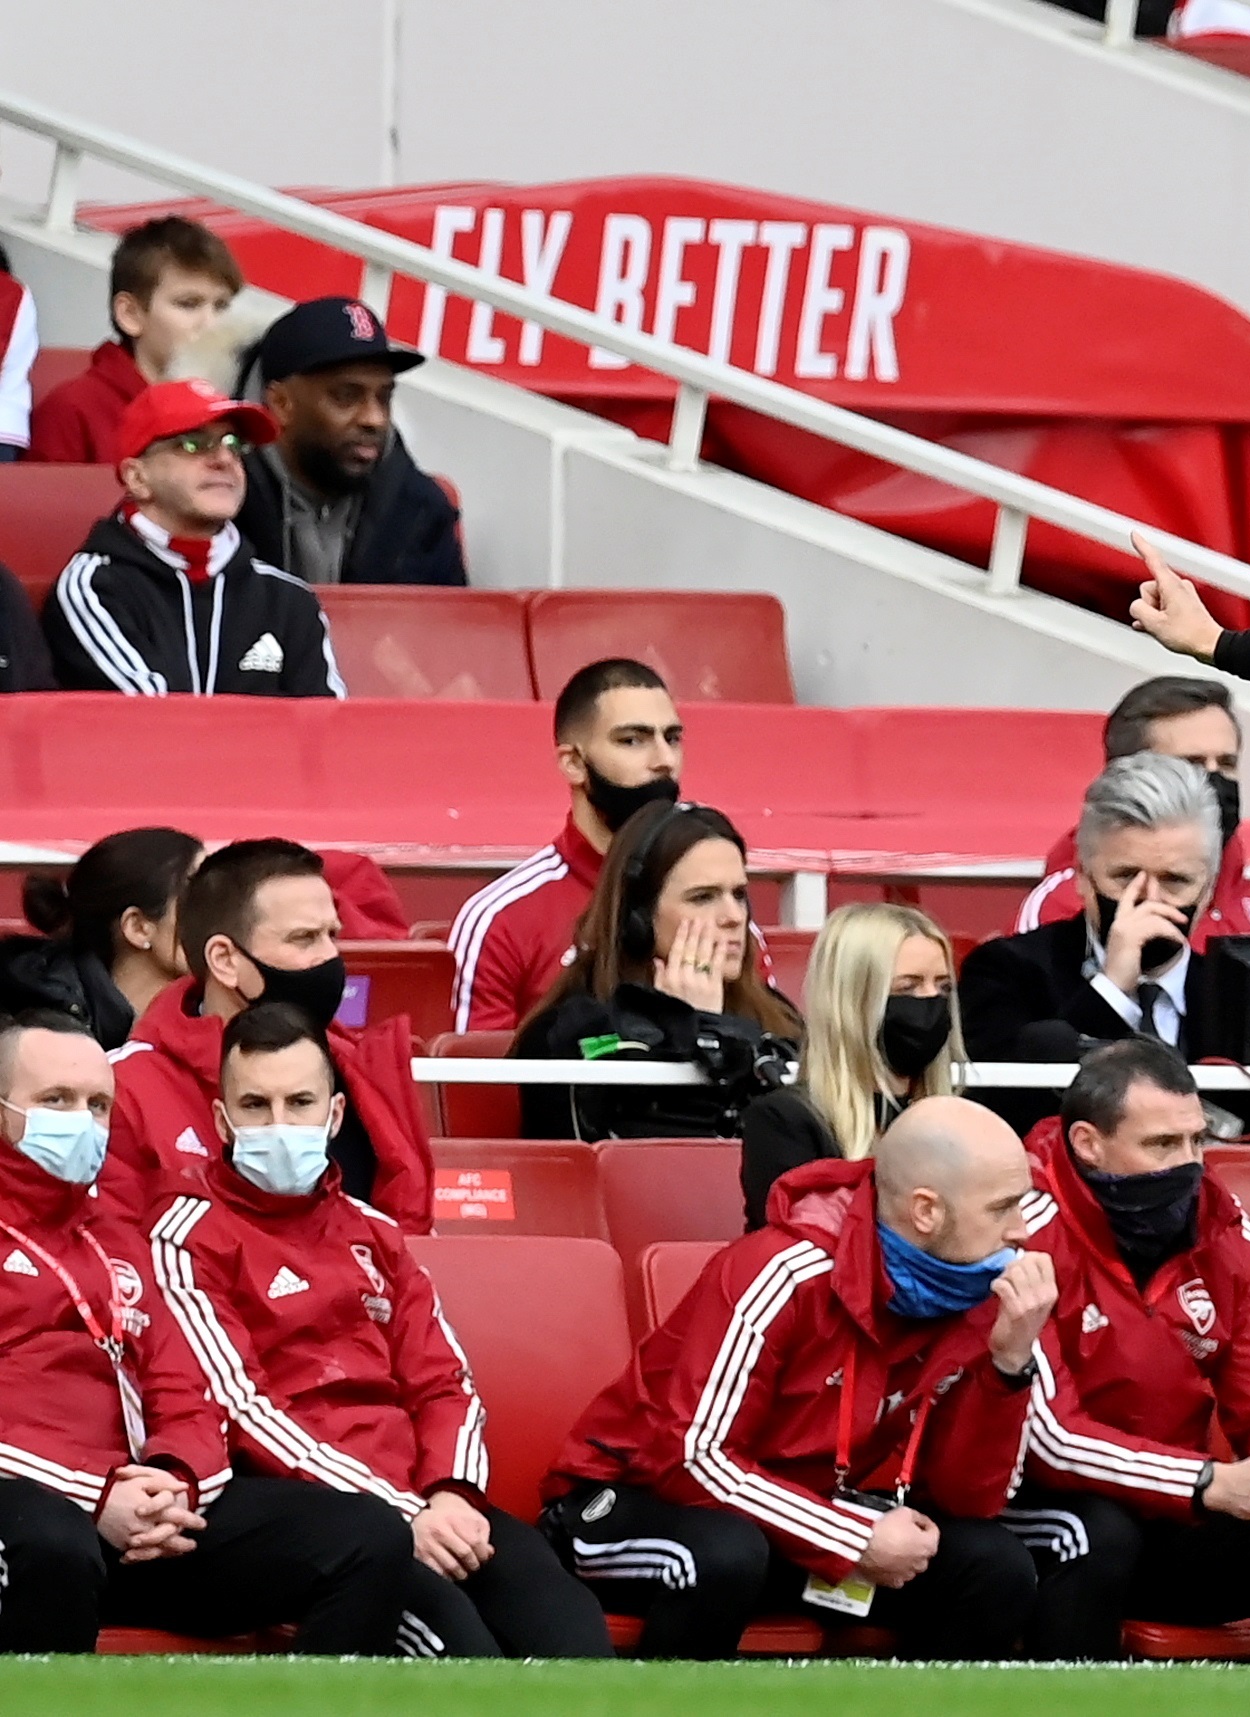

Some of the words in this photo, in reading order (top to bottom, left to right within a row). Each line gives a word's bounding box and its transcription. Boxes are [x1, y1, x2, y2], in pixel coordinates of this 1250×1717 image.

[418, 205, 574, 366] FLY
[588, 212, 911, 382] BETTER
[434, 1187, 507, 1203] COMPLIANCE
